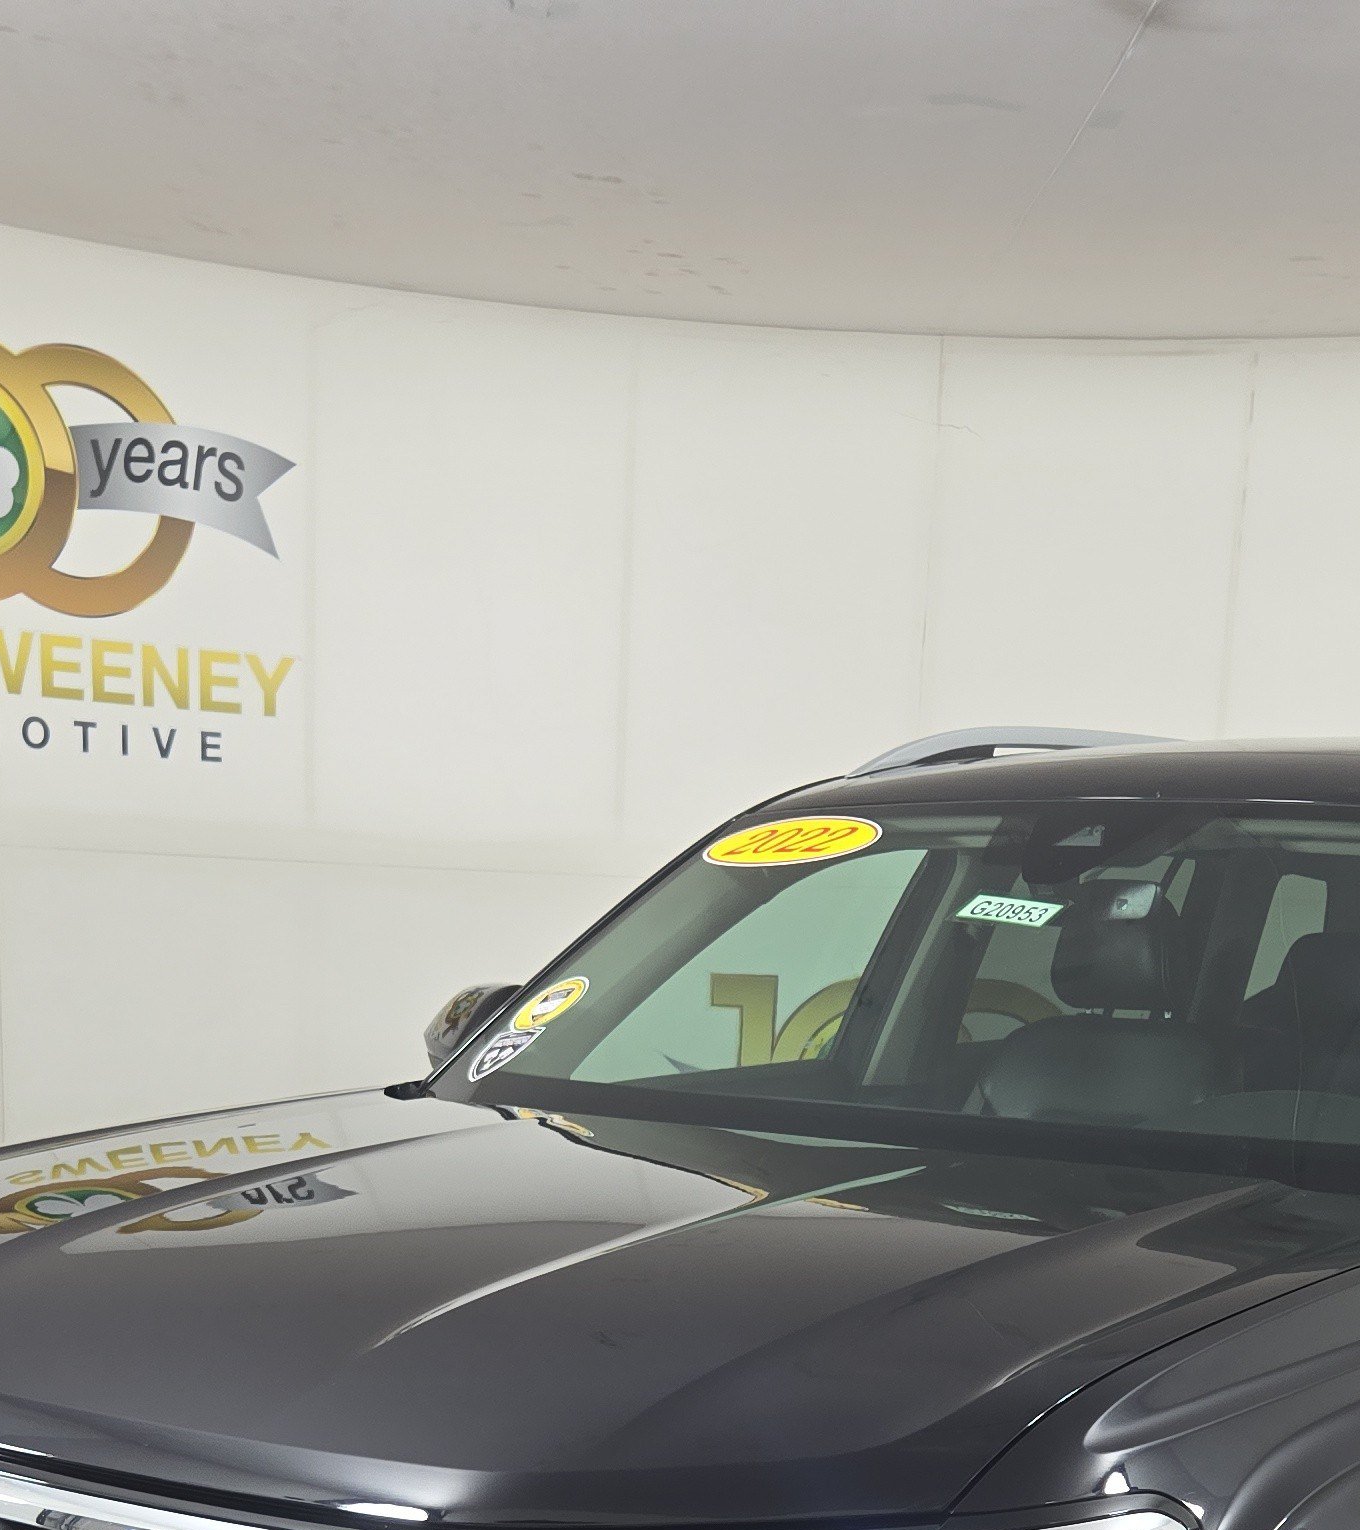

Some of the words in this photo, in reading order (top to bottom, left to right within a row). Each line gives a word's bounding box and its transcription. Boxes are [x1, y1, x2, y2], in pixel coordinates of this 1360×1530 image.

[89, 436, 246, 502] years
[721, 827, 859, 857] 2022
[970, 900, 1049, 923] G20953
